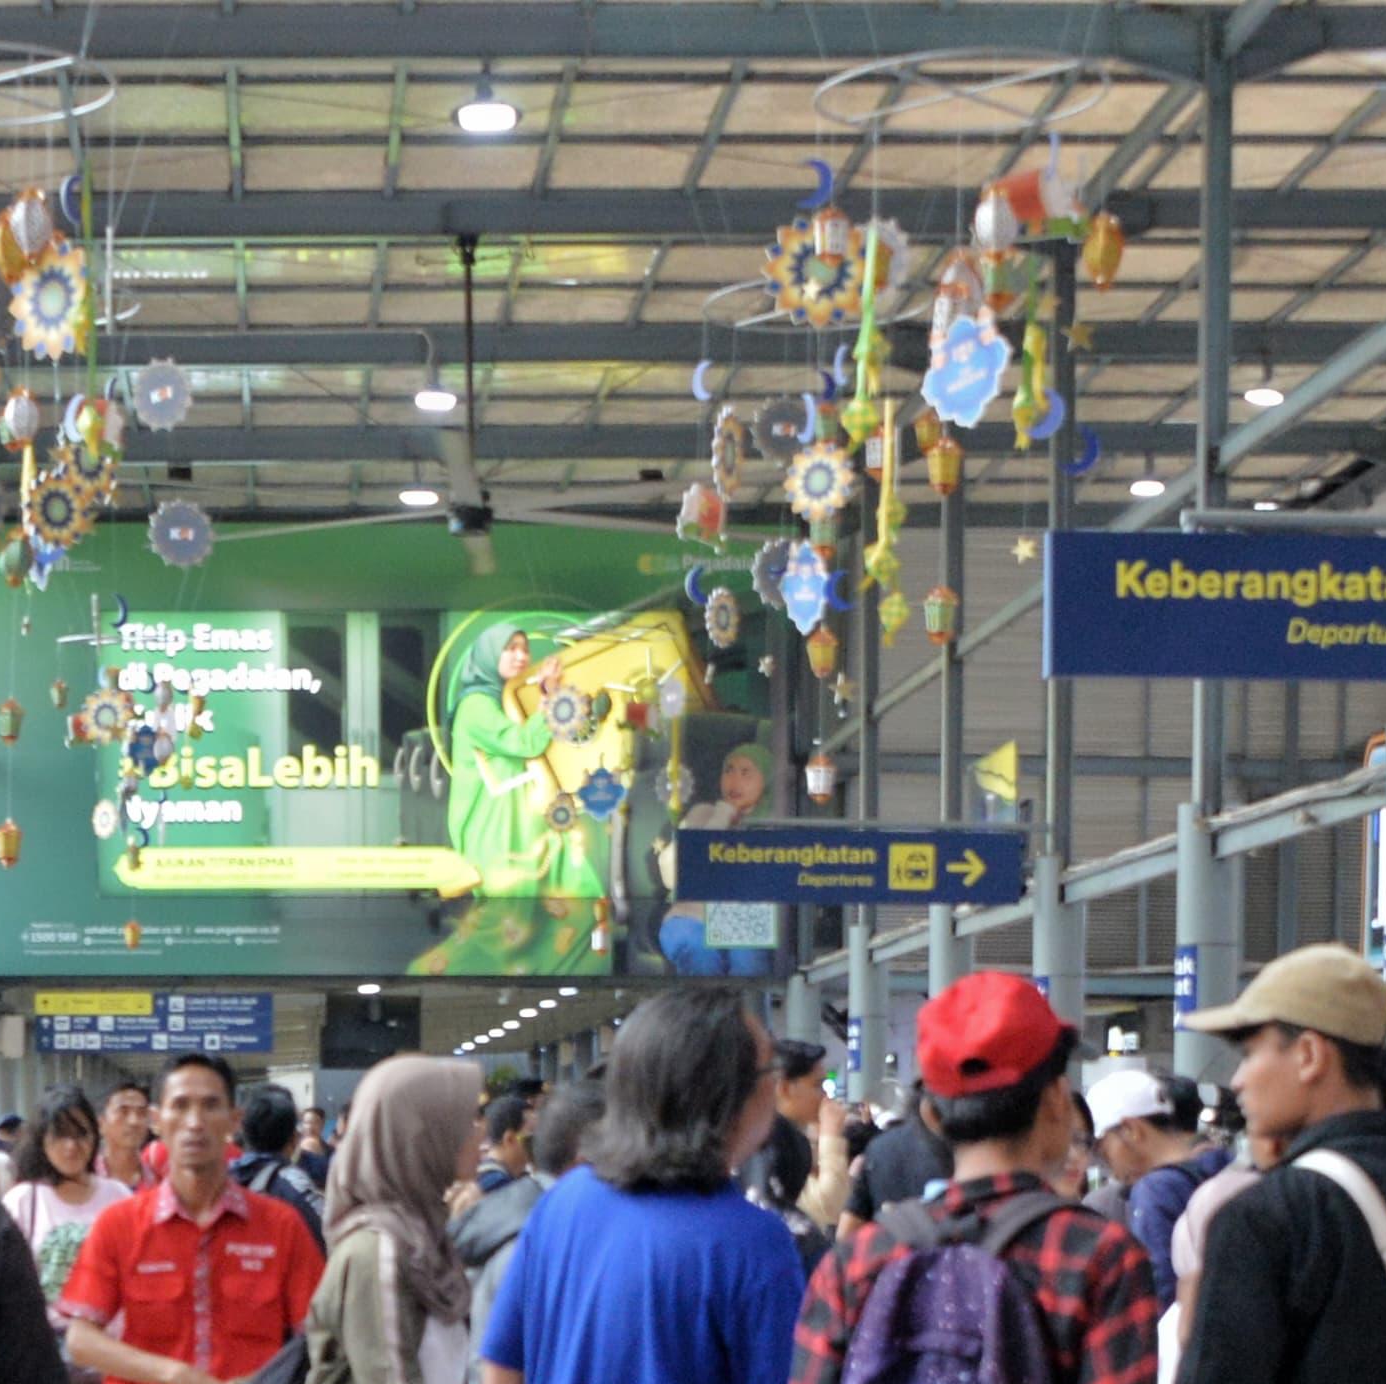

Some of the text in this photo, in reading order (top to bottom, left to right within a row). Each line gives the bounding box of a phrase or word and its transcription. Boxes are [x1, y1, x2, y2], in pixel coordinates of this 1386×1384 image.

[193, 622, 274, 651] Emas
[118, 662, 151, 691] di
[709, 843, 877, 866] Keberangkatan
[798, 872, 874, 887] Departures
